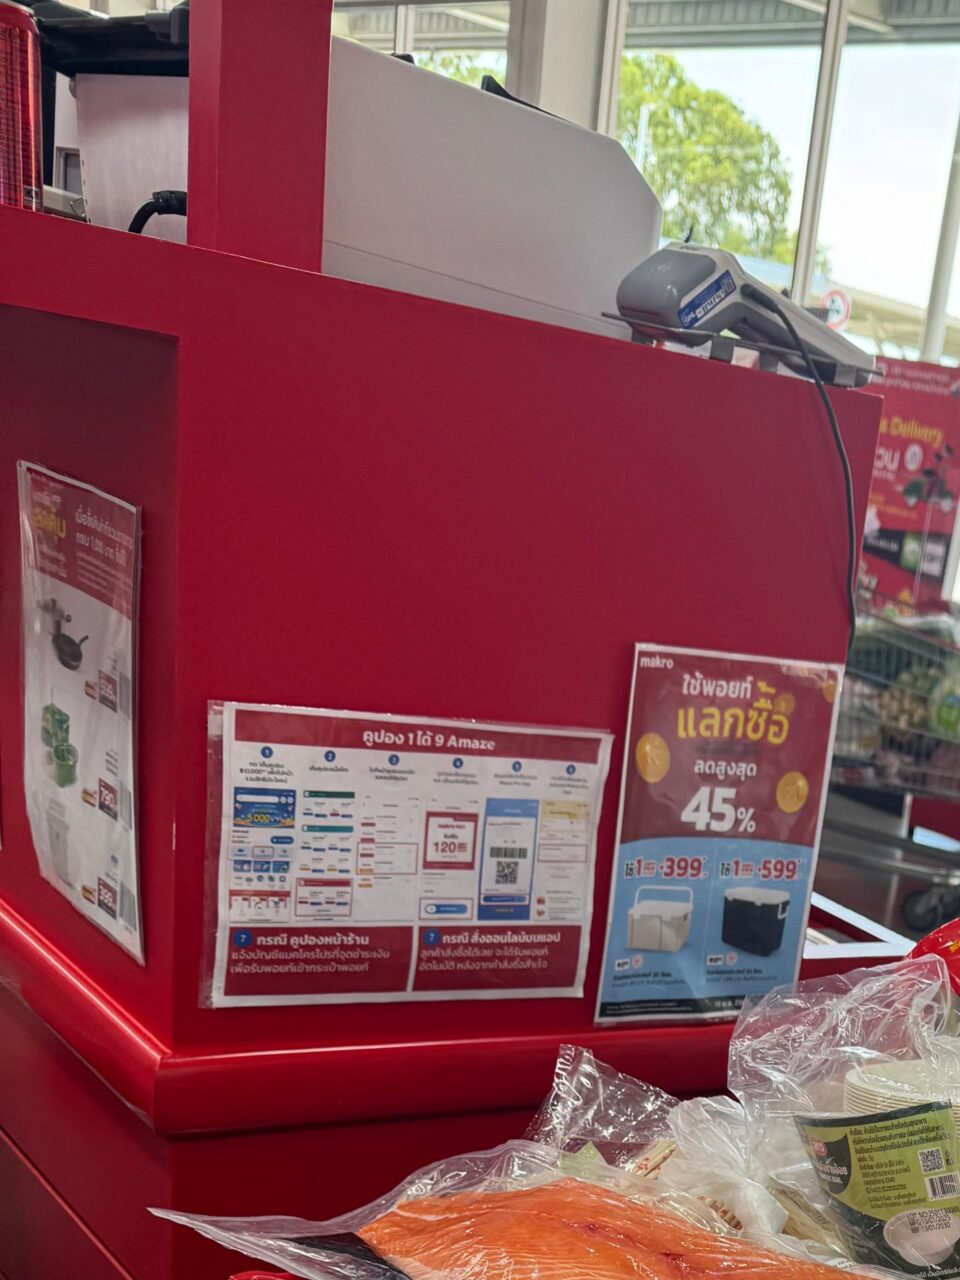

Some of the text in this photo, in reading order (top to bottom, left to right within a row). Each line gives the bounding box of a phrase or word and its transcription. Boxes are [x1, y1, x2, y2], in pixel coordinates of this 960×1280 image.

[640, 655, 674, 669] makro
[682, 671, 754, 699] ใช้พอยท์
[677, 681, 790, 745] แลกซื้อ
[363, 730, 405, 746] คูปอง
[435, 733, 444, 747] 9
[447, 735, 496, 750] Amaze
[694, 759, 758, 780] ลดสูงสุด
[681, 786, 756, 833] 45%
